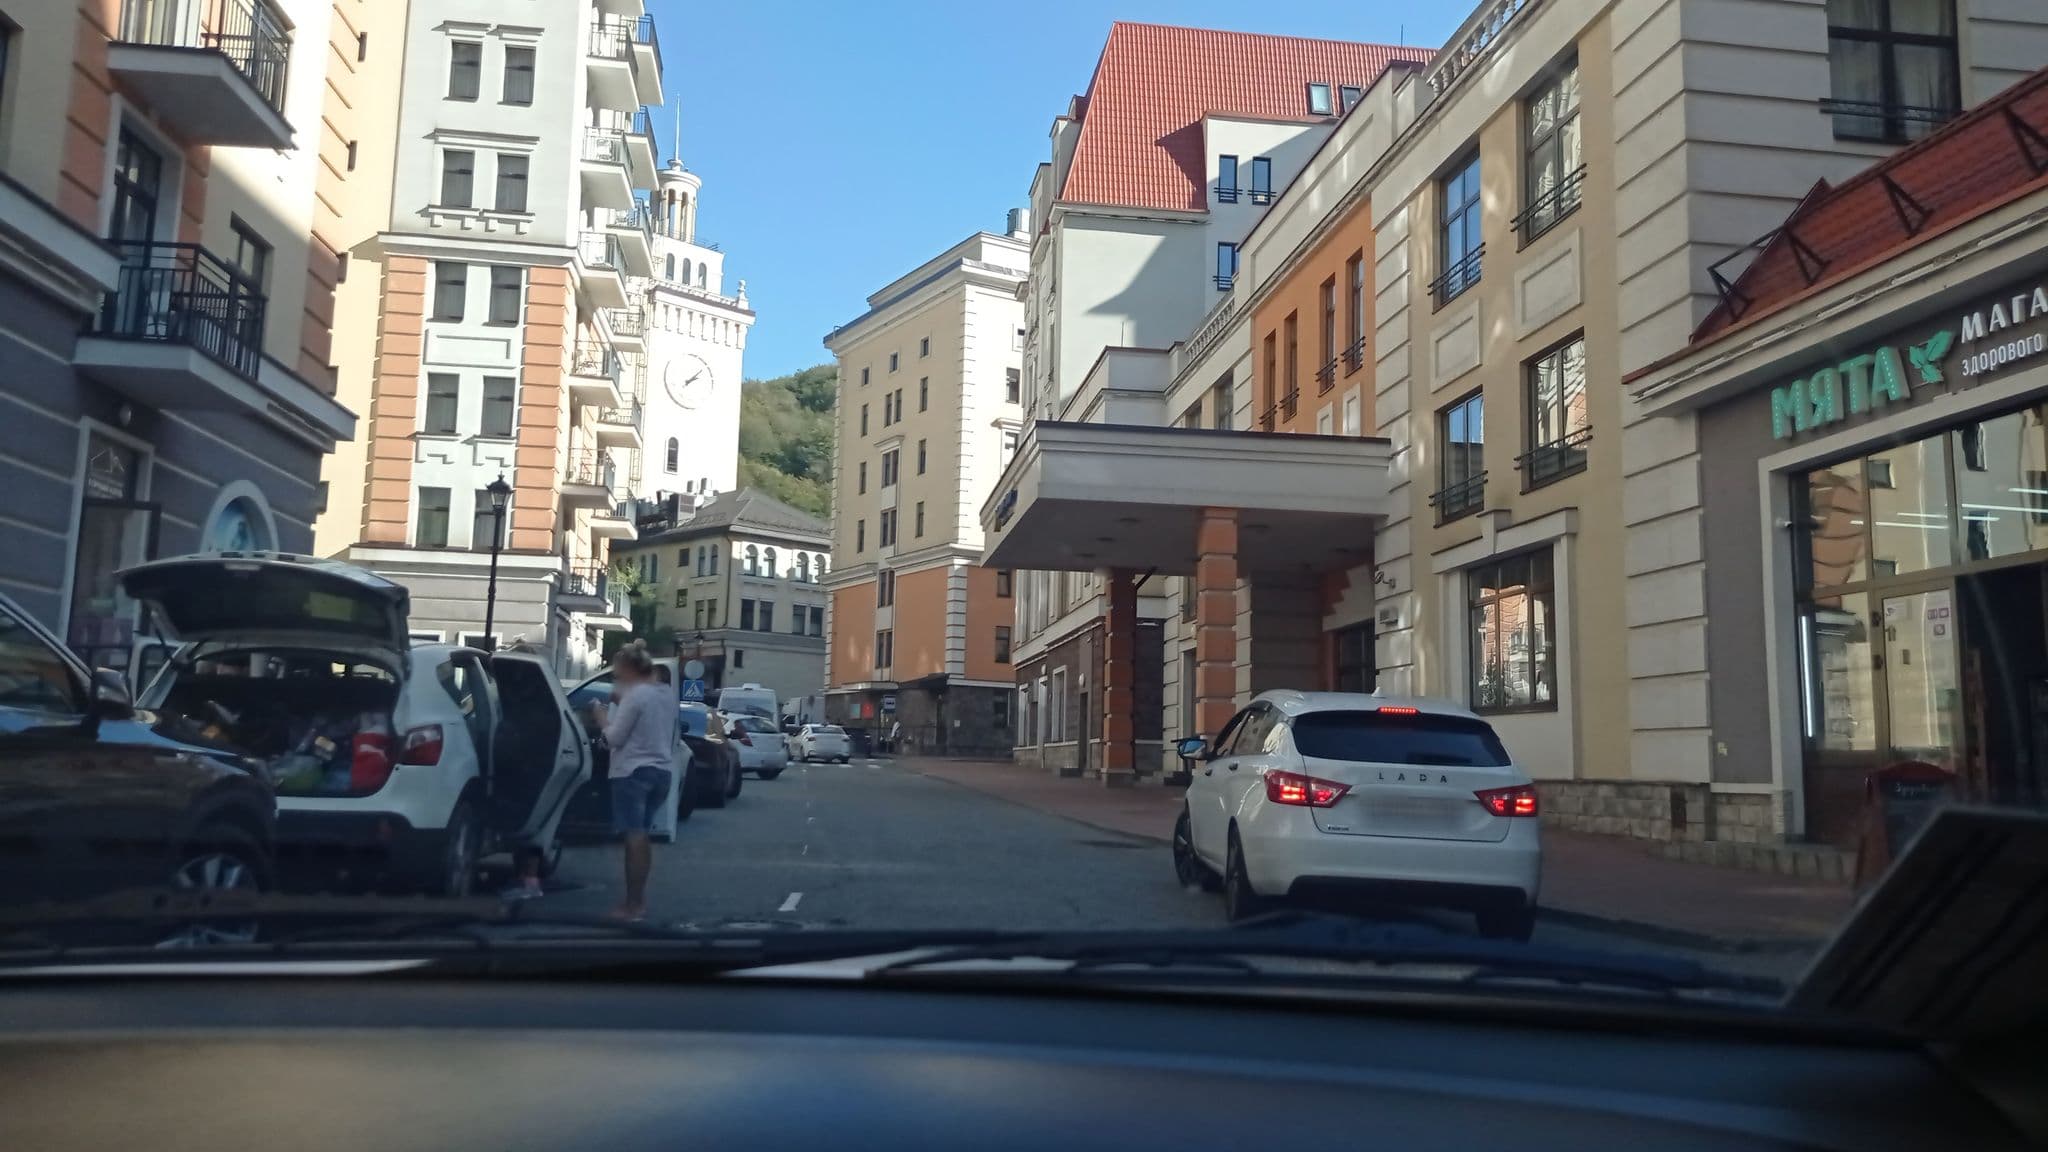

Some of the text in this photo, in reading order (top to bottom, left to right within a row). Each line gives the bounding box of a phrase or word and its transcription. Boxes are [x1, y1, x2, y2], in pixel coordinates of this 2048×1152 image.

[1961, 286, 2048, 344] МАГА
[1961, 333, 2043, 376] ЗДОРОВОГО
[1770, 346, 1911, 440] МЯТА
[1378, 771, 1448, 784] LADA
